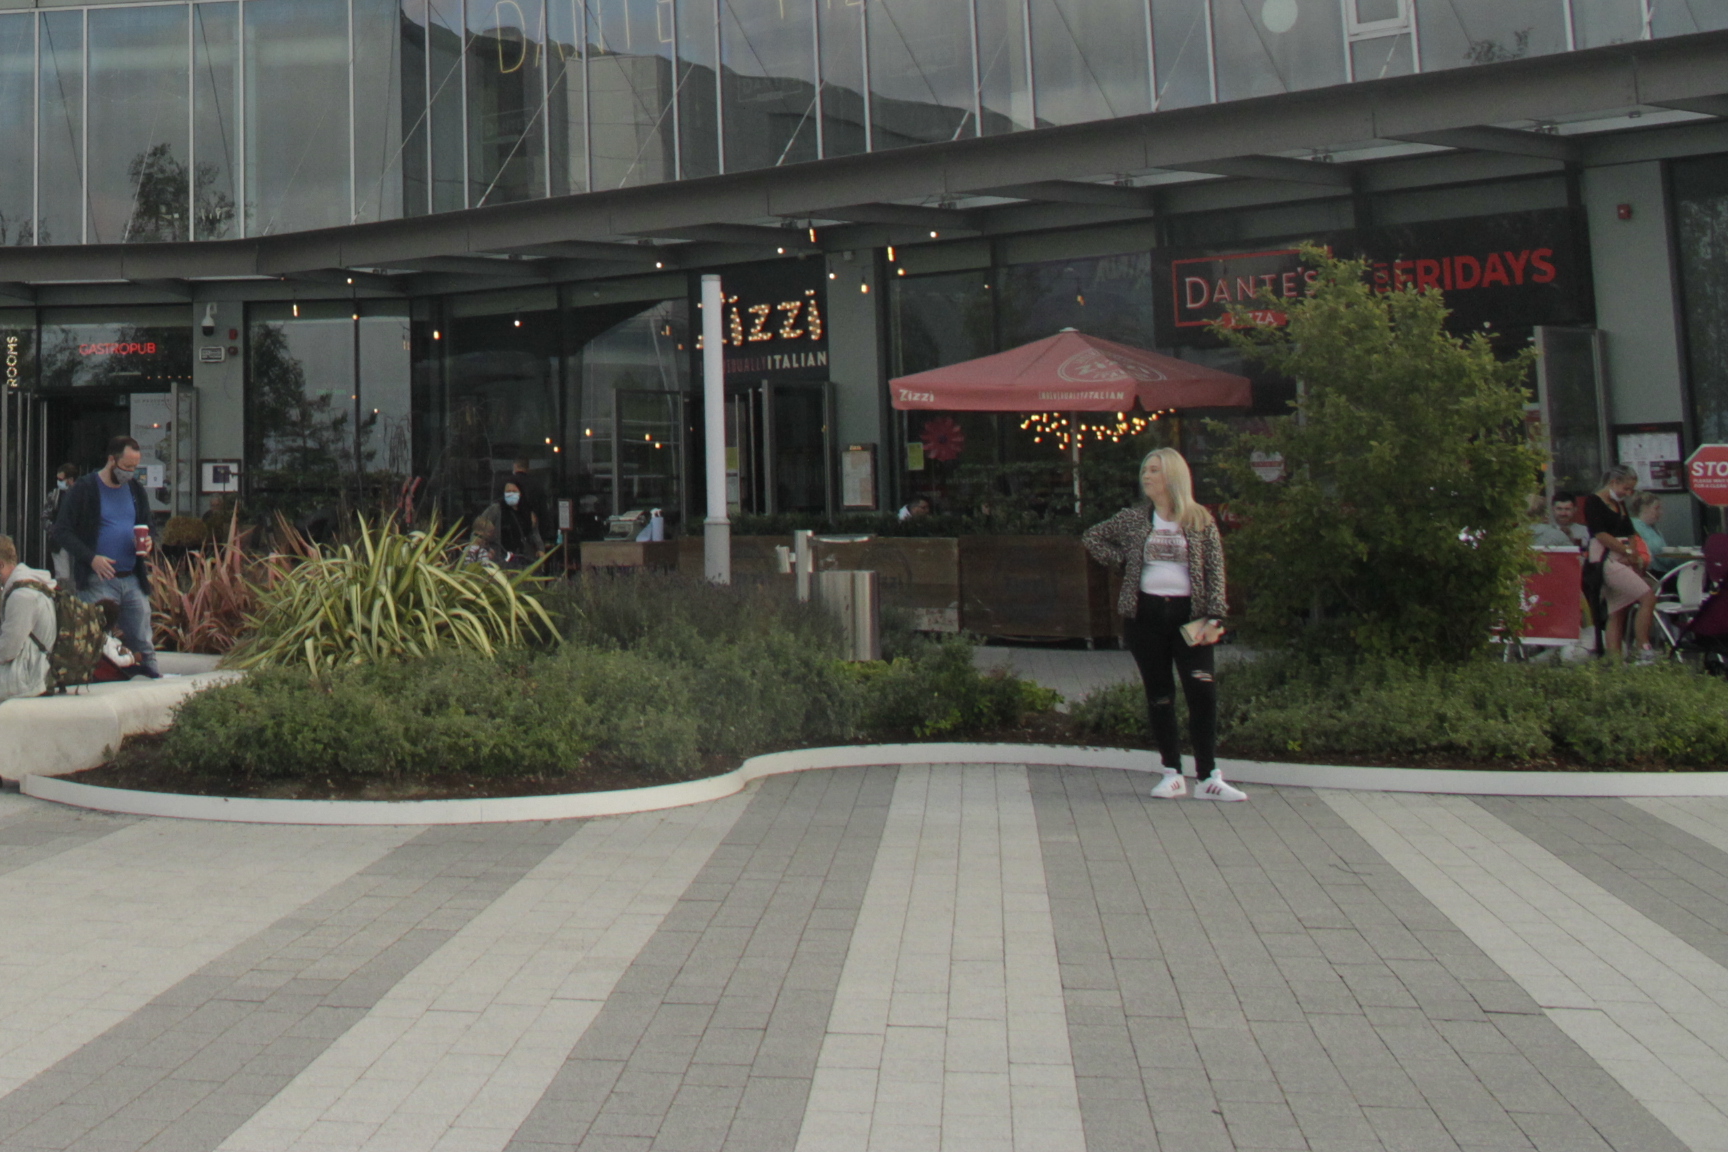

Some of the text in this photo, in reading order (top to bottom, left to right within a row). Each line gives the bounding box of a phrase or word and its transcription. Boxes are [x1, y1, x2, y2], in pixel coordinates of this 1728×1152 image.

[1393, 248, 1557, 294] FRIDAYS
[6, 335, 18, 388] ROOMS
[79, 342, 156, 356] GASTROPUB
